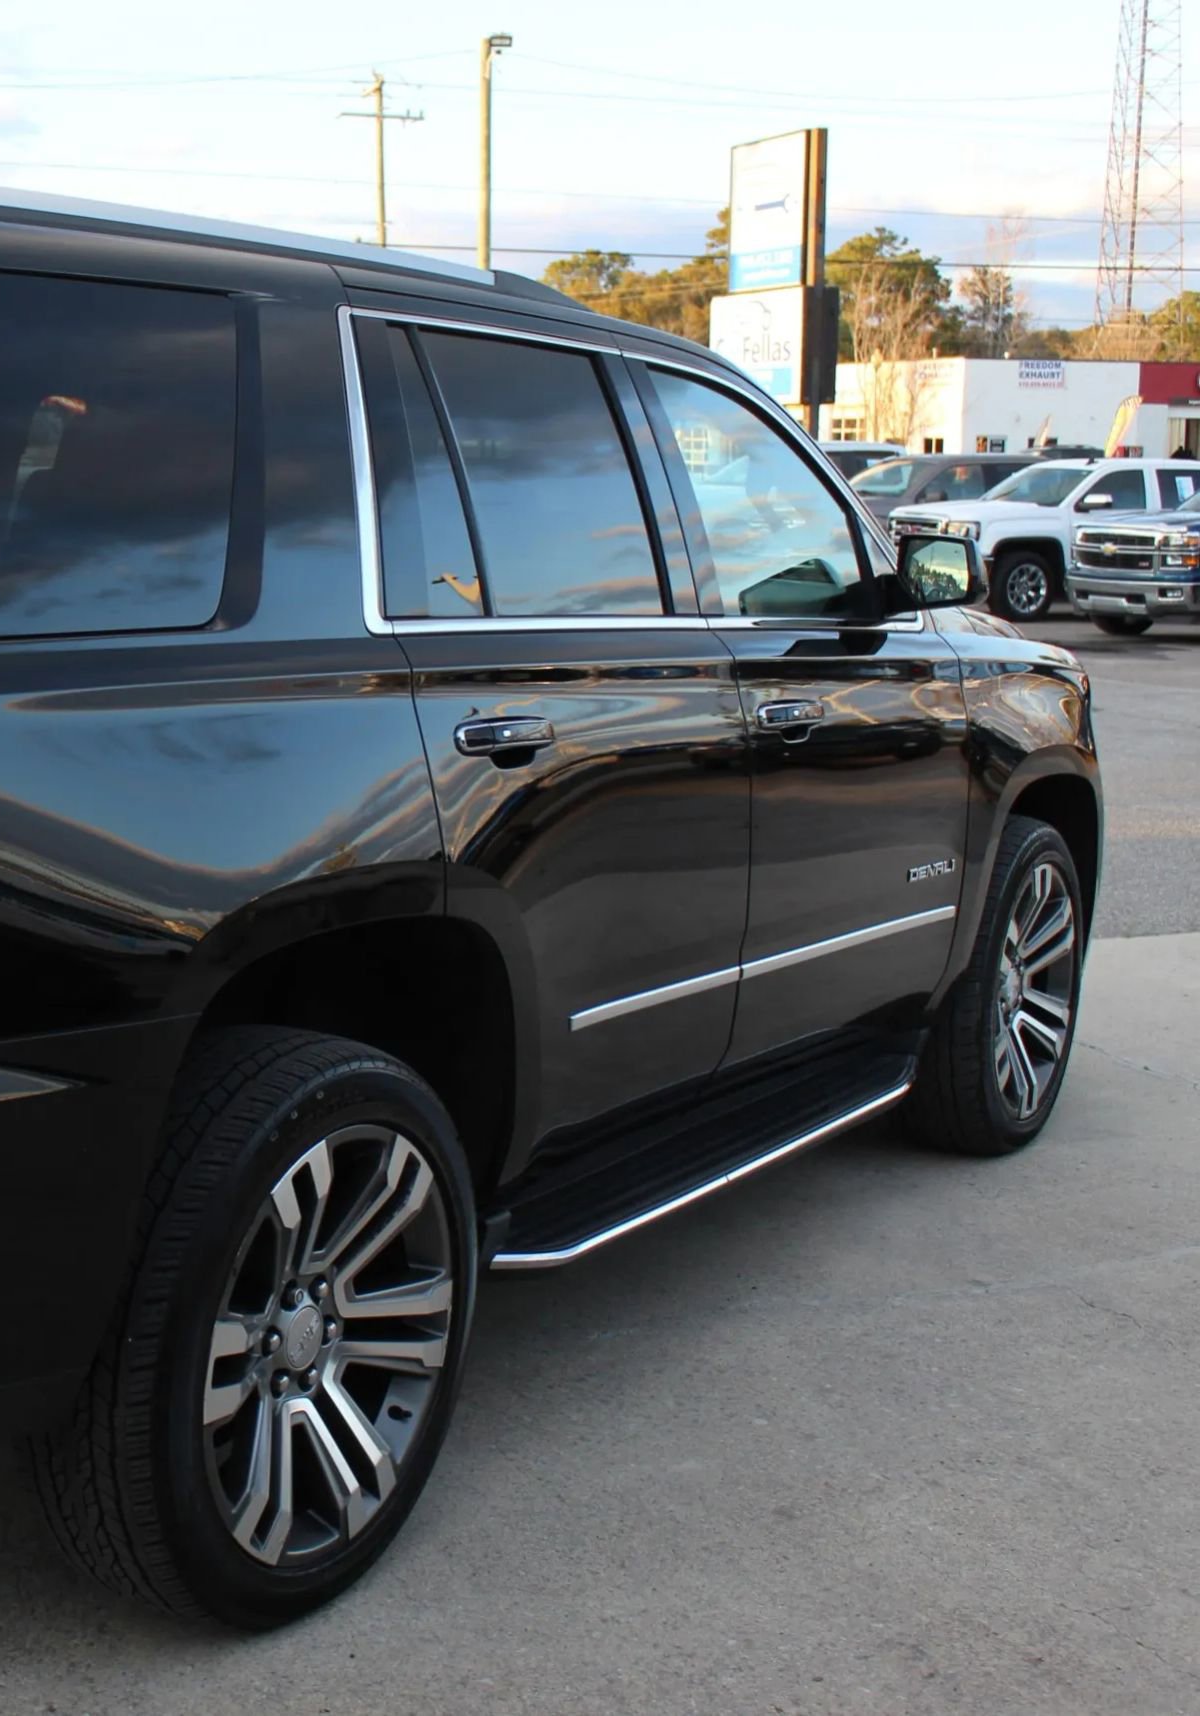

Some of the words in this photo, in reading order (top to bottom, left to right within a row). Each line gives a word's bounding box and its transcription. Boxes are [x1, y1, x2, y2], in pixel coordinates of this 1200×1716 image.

[1018, 360, 1061, 369] FREEDOM
[1018, 370, 1060, 379] EXHAUST
[907, 858, 956, 883] DENALI
